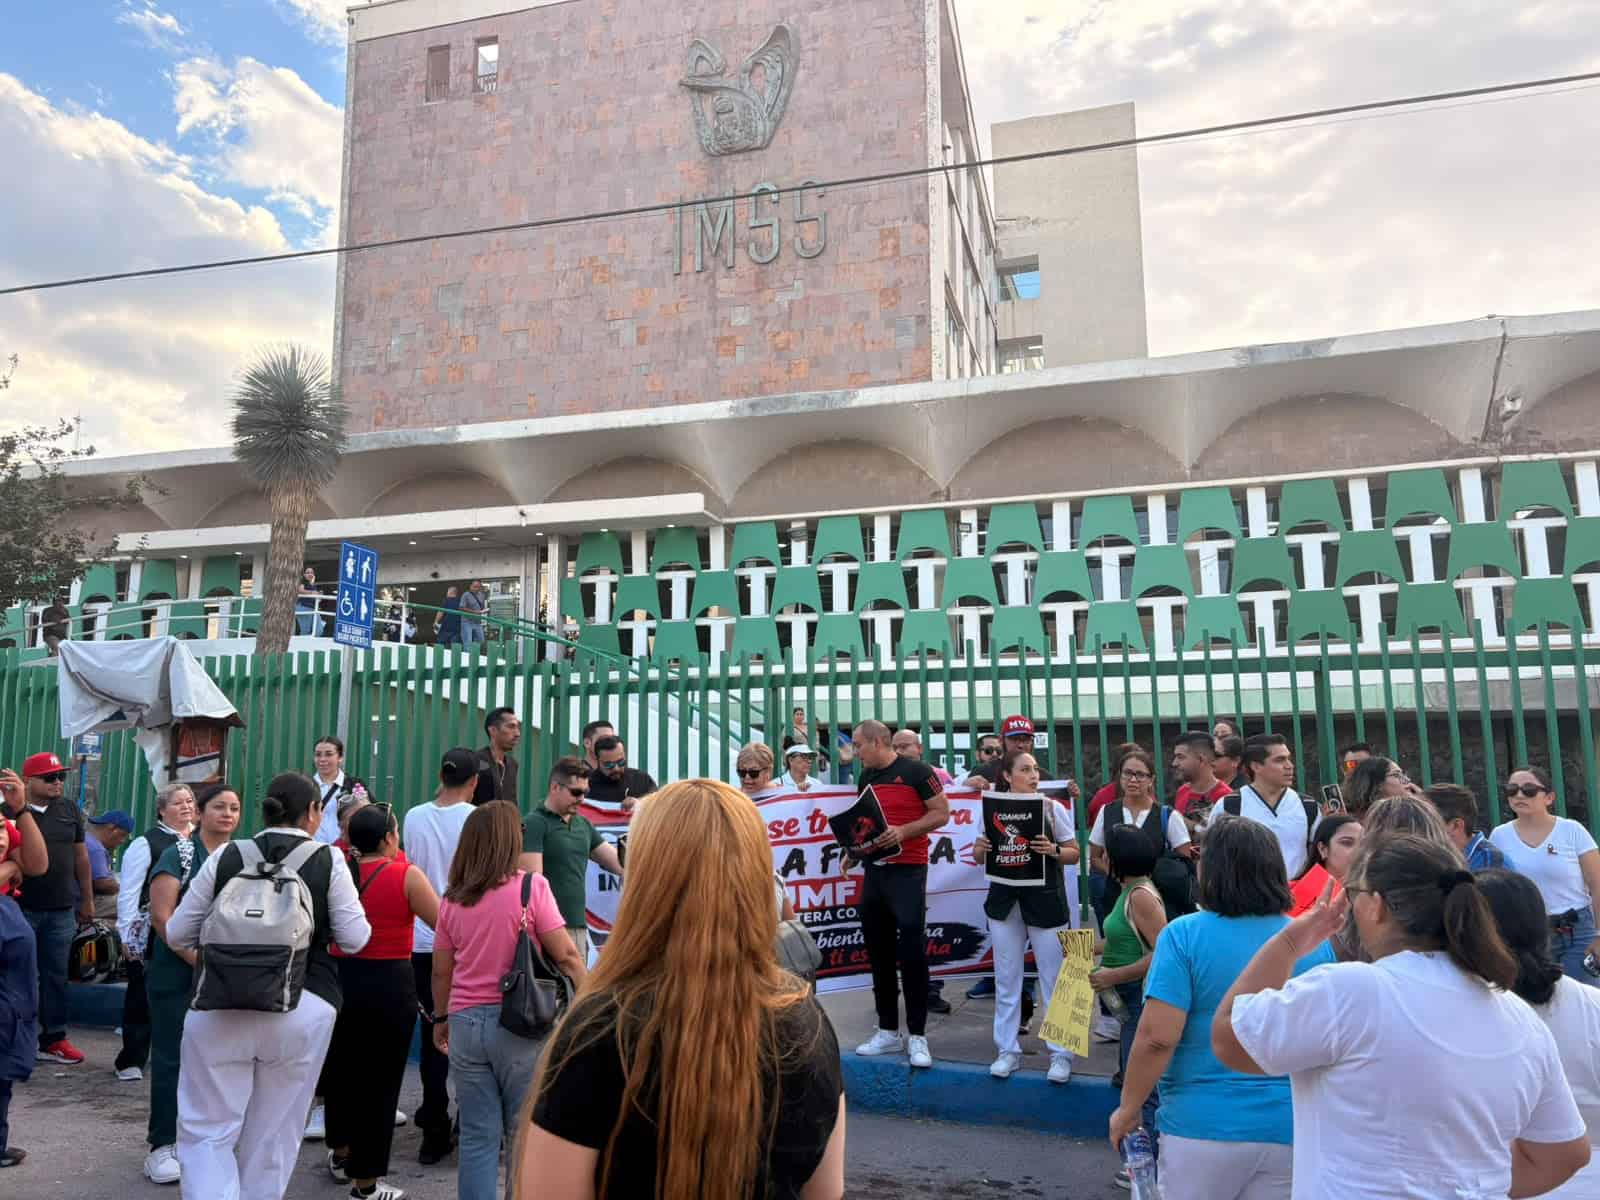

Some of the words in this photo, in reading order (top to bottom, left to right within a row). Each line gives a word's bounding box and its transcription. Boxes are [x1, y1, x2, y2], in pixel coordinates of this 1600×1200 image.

[673, 180, 826, 276] IMSS
[998, 812, 1033, 821] COAHUILA
[998, 843, 1027, 852] UNIDOS
[781, 848, 807, 878] A
[995, 854, 1031, 864] FUERTES
[794, 909, 832, 922] TERA
[836, 907, 860, 919] CO
